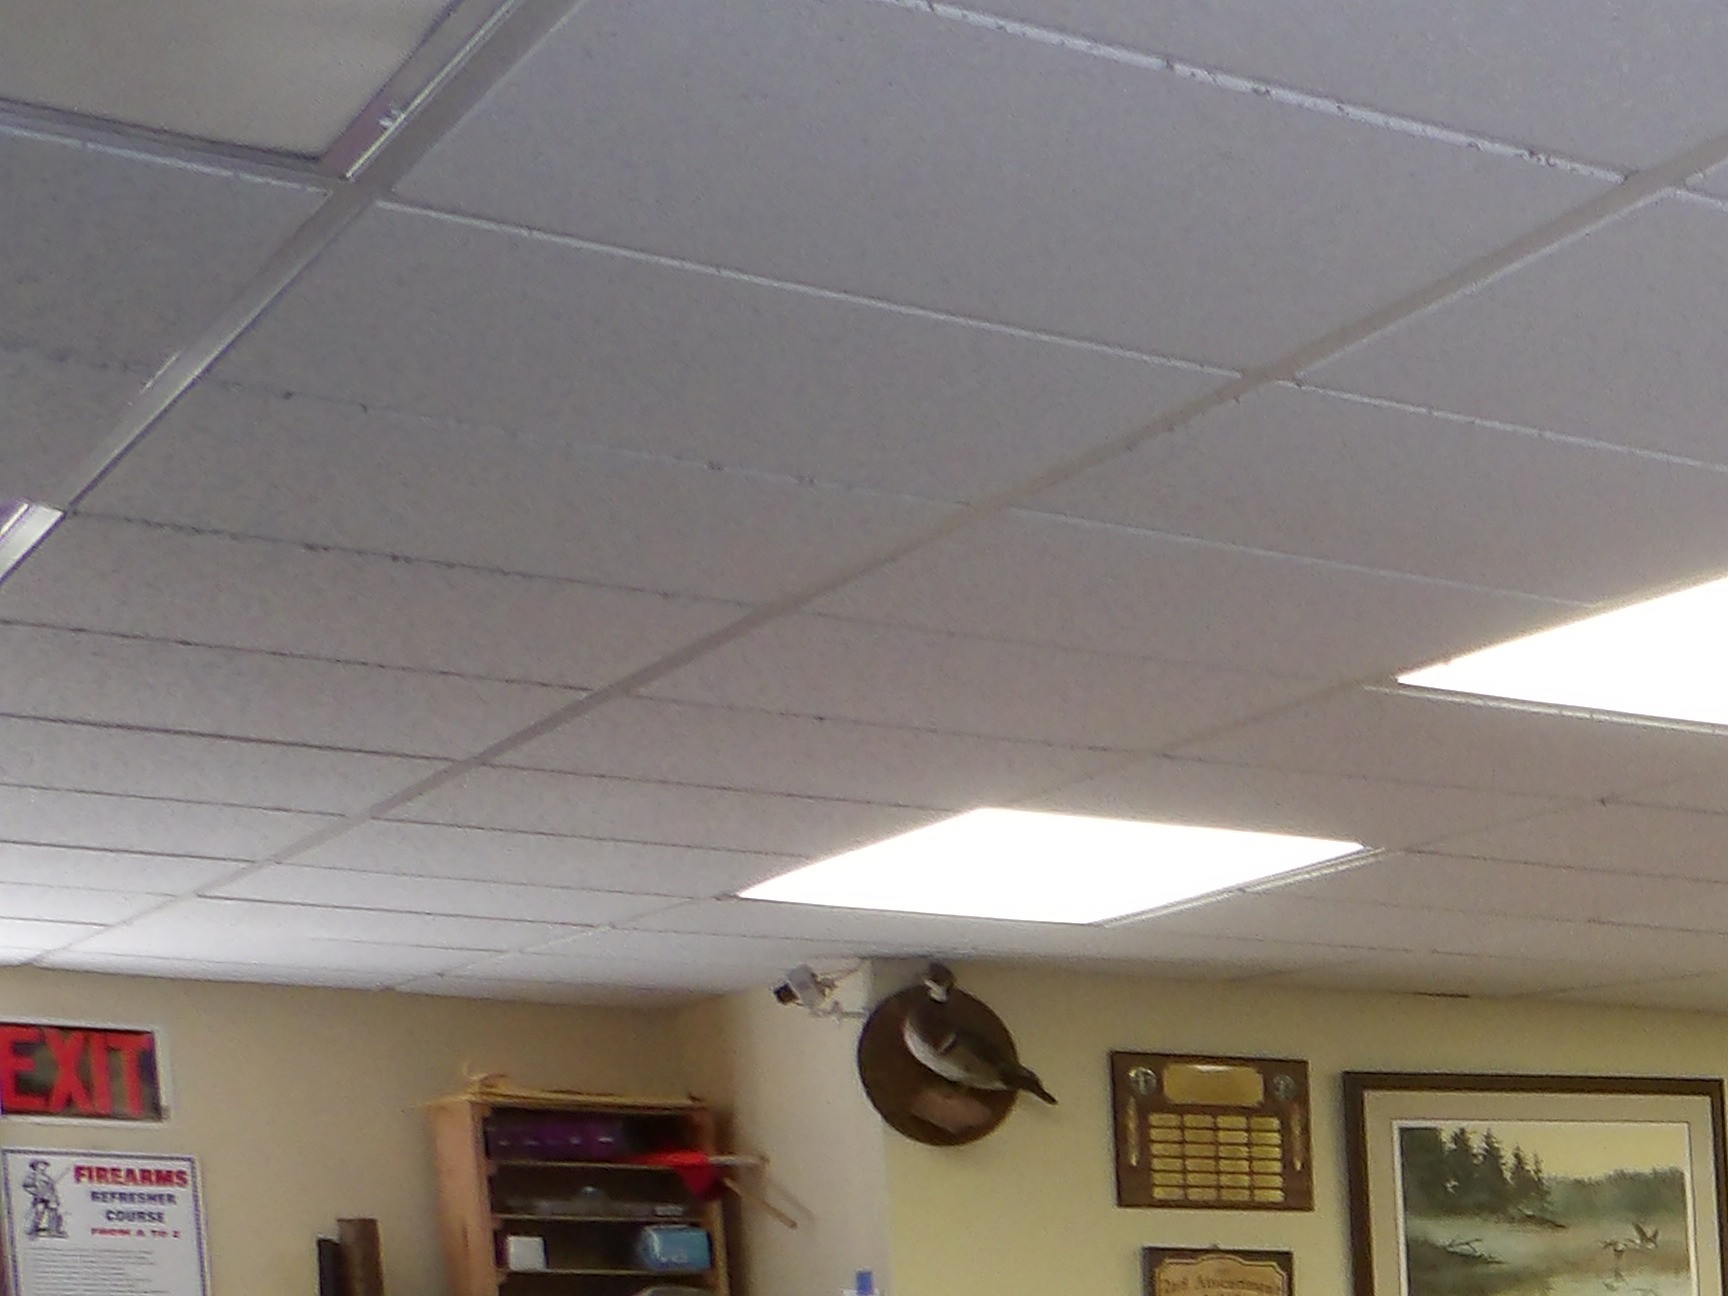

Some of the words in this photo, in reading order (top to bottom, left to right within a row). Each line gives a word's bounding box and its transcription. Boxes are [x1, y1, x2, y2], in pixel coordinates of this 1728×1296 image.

[0, 1025, 153, 1118] EXIT
[74, 1165, 188, 1187] FIREARMS
[90, 1191, 177, 1205] REFRESHER
[106, 1210, 165, 1223] COURSE
